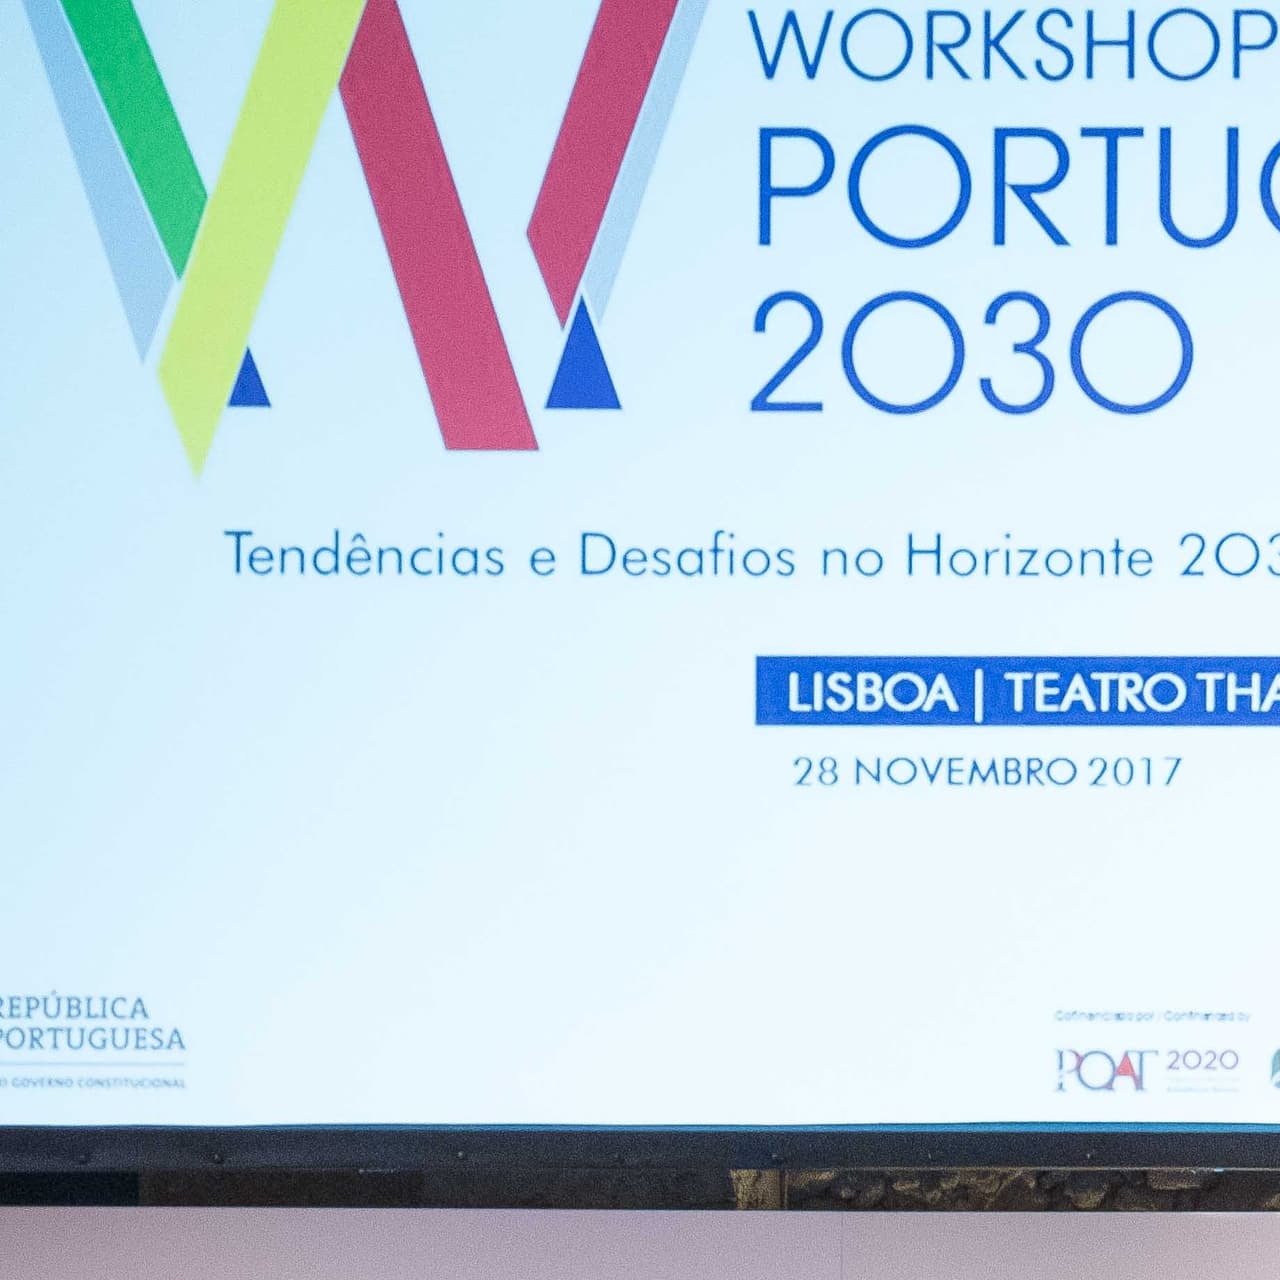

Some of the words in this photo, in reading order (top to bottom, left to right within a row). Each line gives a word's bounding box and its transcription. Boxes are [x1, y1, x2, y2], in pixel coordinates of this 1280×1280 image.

[748, 8, 1278, 81] WORKSHOP
[750, 291, 1193, 415] 2030
[224, 531, 504, 576] Tendências
[530, 548, 555, 576] e
[581, 530, 794, 576] Desafios
[823, 549, 883, 576] no
[908, 533, 1152, 576] Horizonte
[789, 672, 959, 712] LISBOA
[1004, 672, 1186, 712] TEATRO
[794, 757, 838, 785] 28
[856, 758, 1077, 785] NOVEMBRO
[1089, 758, 1181, 785] 2017
[0, 991, 149, 1019] EPÚBLICA
[0, 1027, 185, 1050] ORTUGUESA
[1167, 1050, 1239, 1070] 2020
